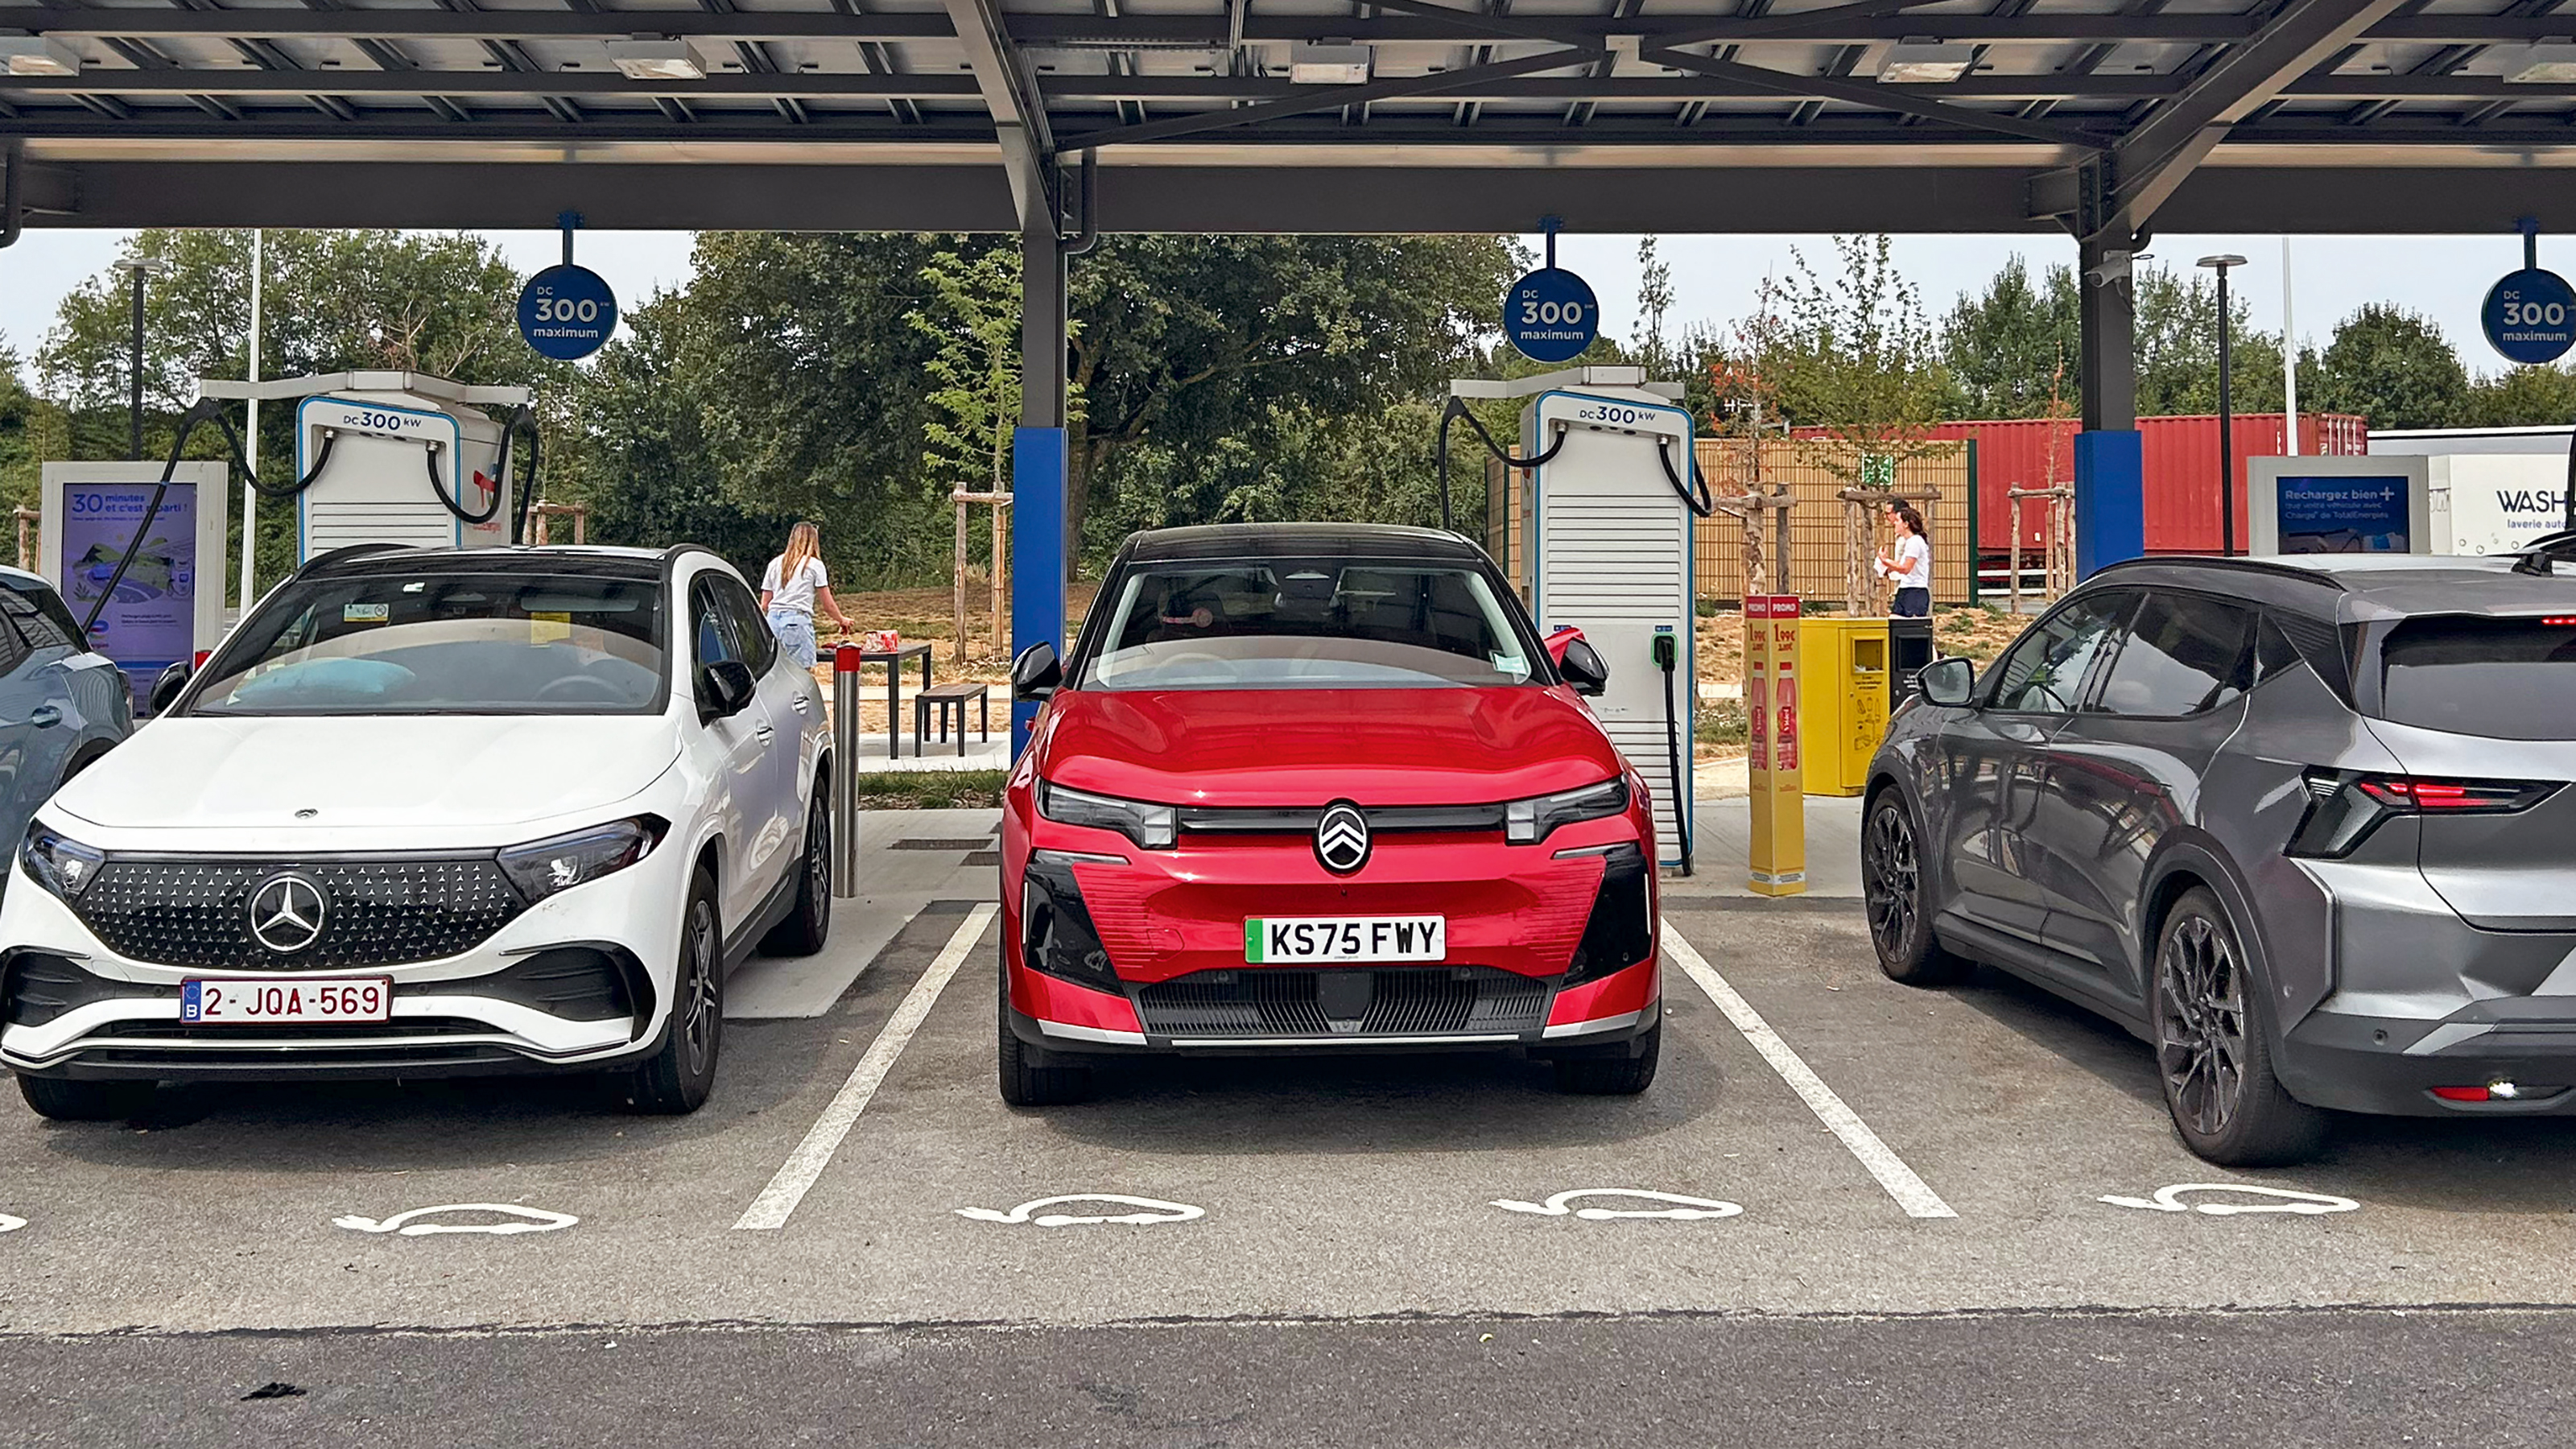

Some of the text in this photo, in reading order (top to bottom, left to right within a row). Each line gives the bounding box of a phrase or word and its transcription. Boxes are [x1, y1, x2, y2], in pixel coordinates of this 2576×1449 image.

[537, 287, 554, 295] DC
[1522, 290, 1538, 299] DC
[2503, 291, 2520, 299] DC
[535, 299, 597, 322] 300
[1521, 301, 1582, 324] 300
[2503, 302, 2565, 325] 300
[533, 327, 598, 338] maximum
[1520, 329, 1583, 340] maximum
[2503, 330, 2567, 341] maximum
[1579, 406, 1656, 423] DC 300 kW
[343, 411, 421, 431] DC 300 kW
[2285, 489, 2349, 501] Rechargez
[2351, 489, 2378, 499] bien
[72, 493, 145, 513] 30 minutes
[2496, 490, 2568, 513] WASH
[105, 504, 116, 512] et
[2508, 519, 2542, 528] laverie
[1772, 603, 1796, 612] PROMO
[1271, 922, 1437, 956] KS75 FWY
[186, 1005, 198, 1018] B
